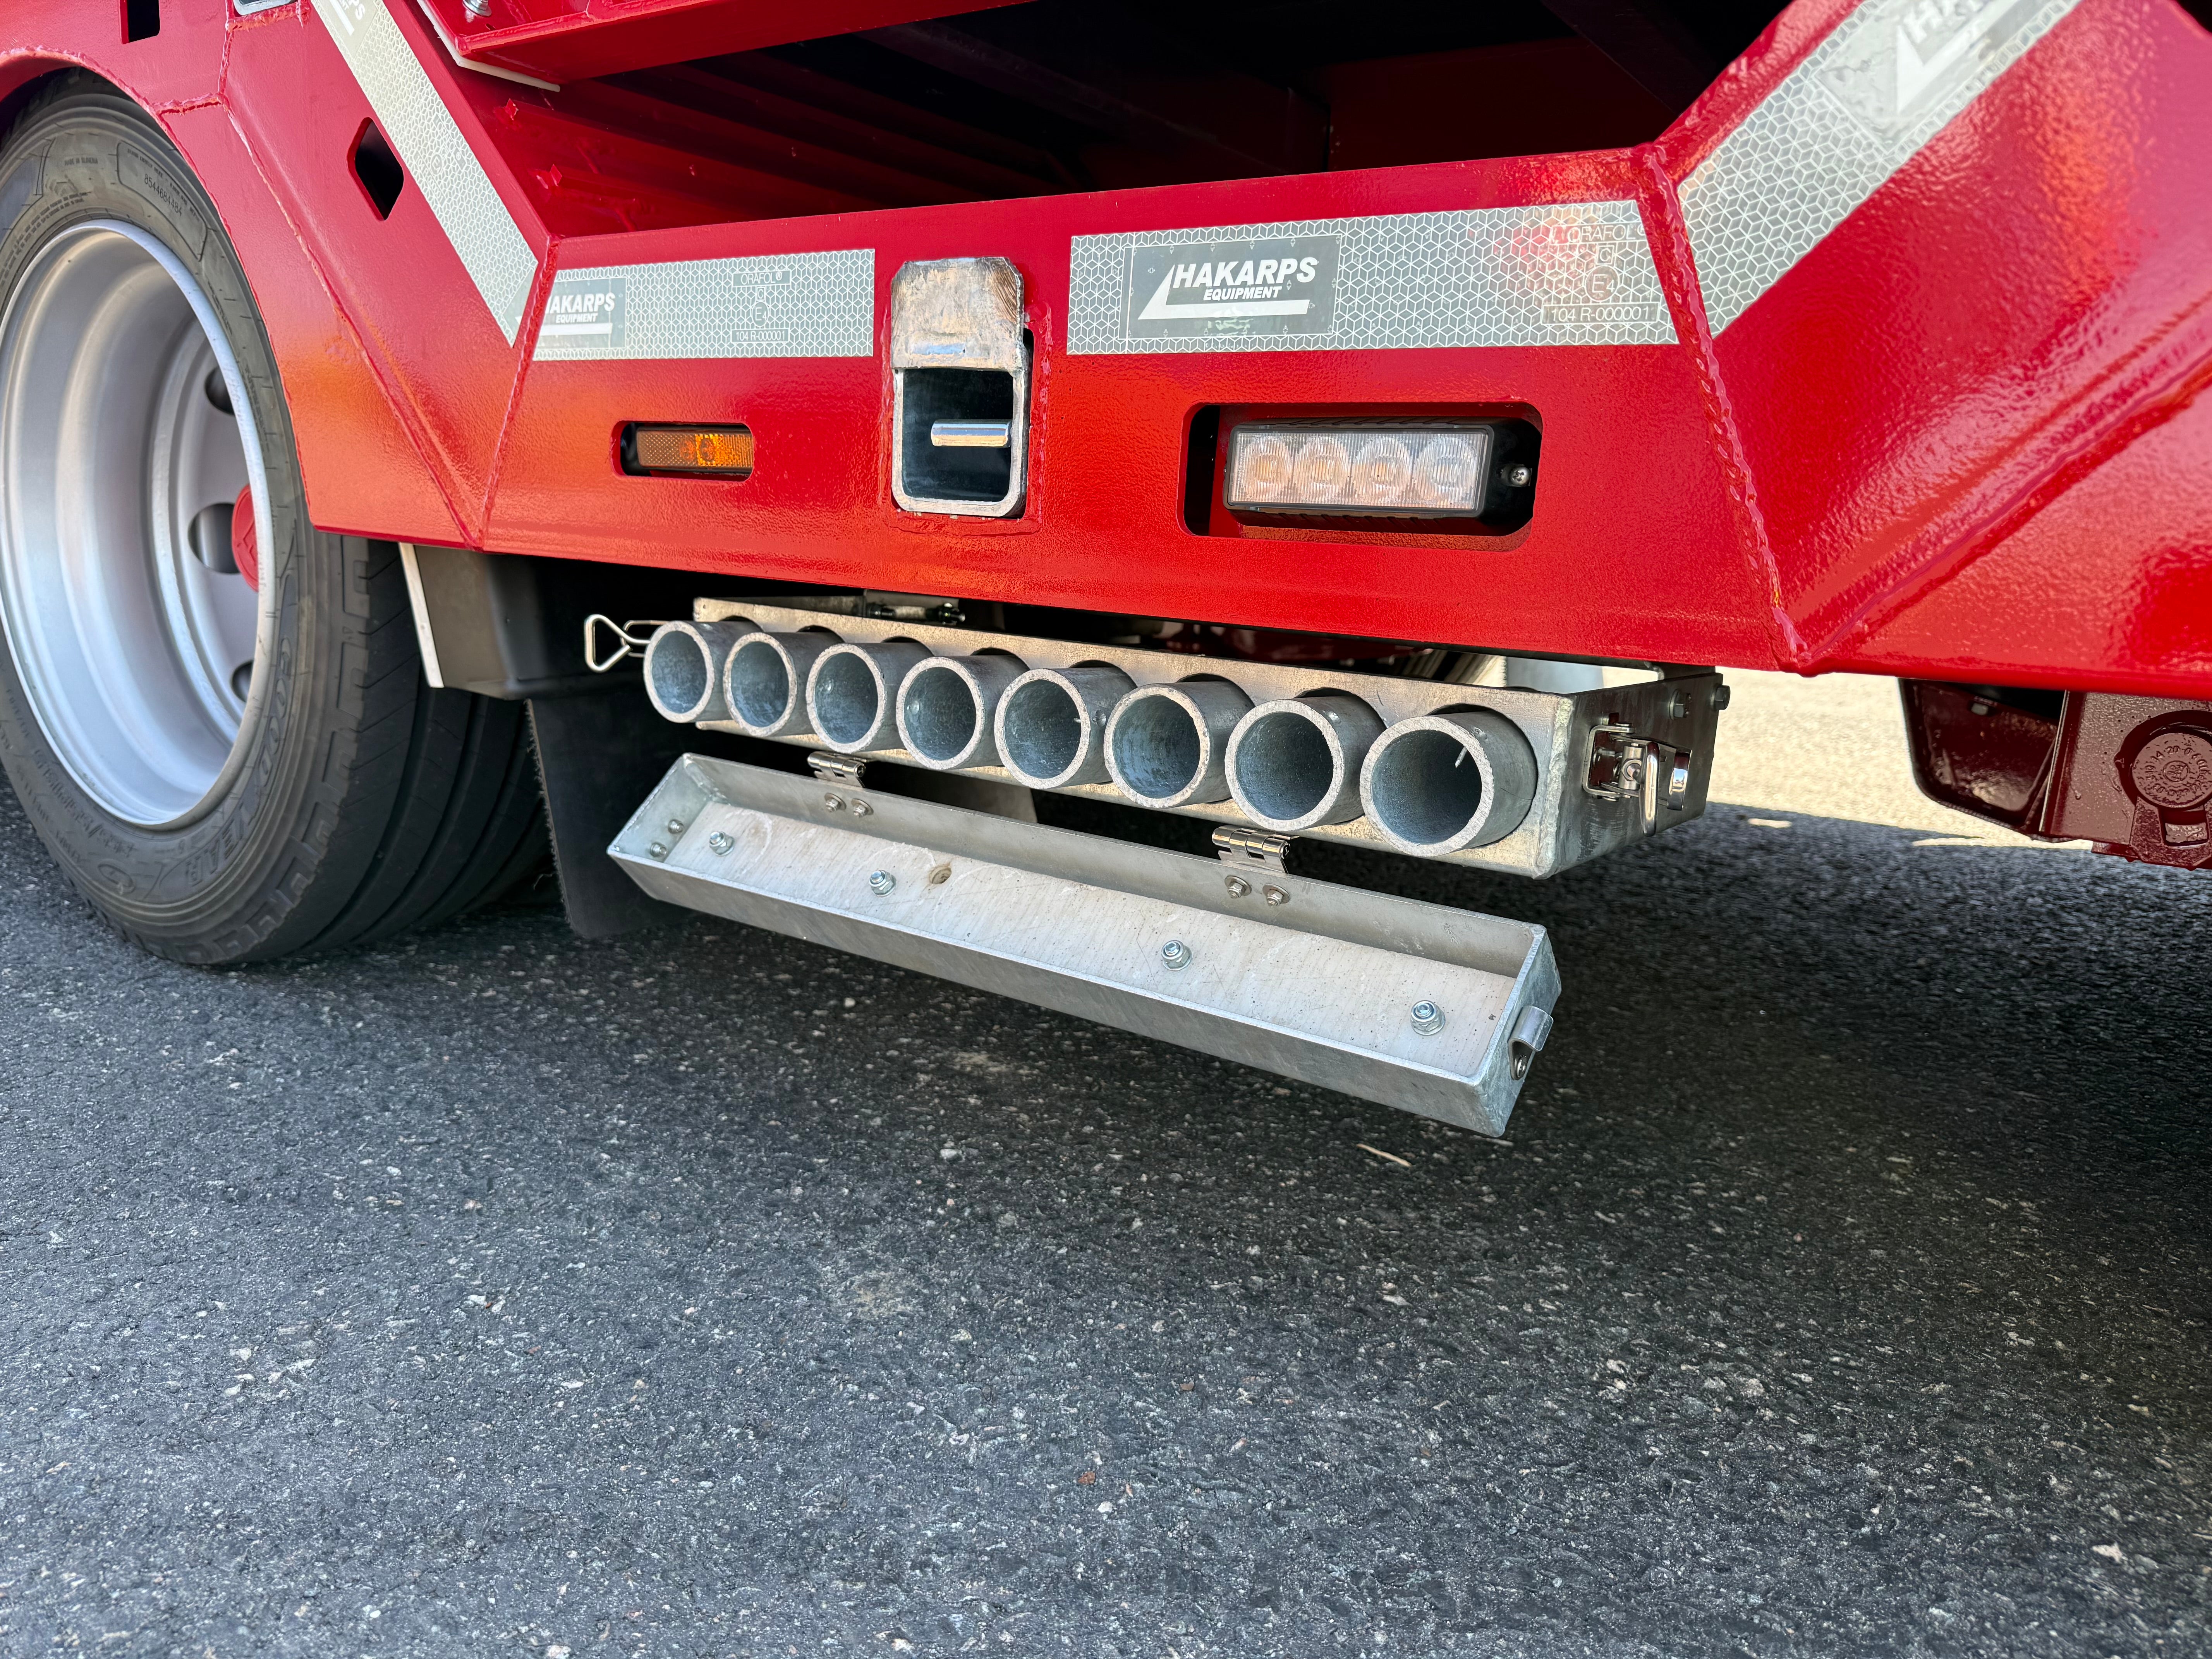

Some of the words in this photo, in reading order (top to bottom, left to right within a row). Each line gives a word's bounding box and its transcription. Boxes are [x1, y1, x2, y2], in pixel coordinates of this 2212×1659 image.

[144, 173, 182, 216] 8544684484
[1173, 257, 1319, 289] HAKARPS
[1203, 286, 1283, 301] EQUIPMENT
[555, 313, 598, 324] EQUIPMENT
[1551, 307, 1576, 322] 104
[1580, 306, 1649, 321] R-000001
[736, 331, 748, 341] 104
[750, 330, 785, 341] R-000001
